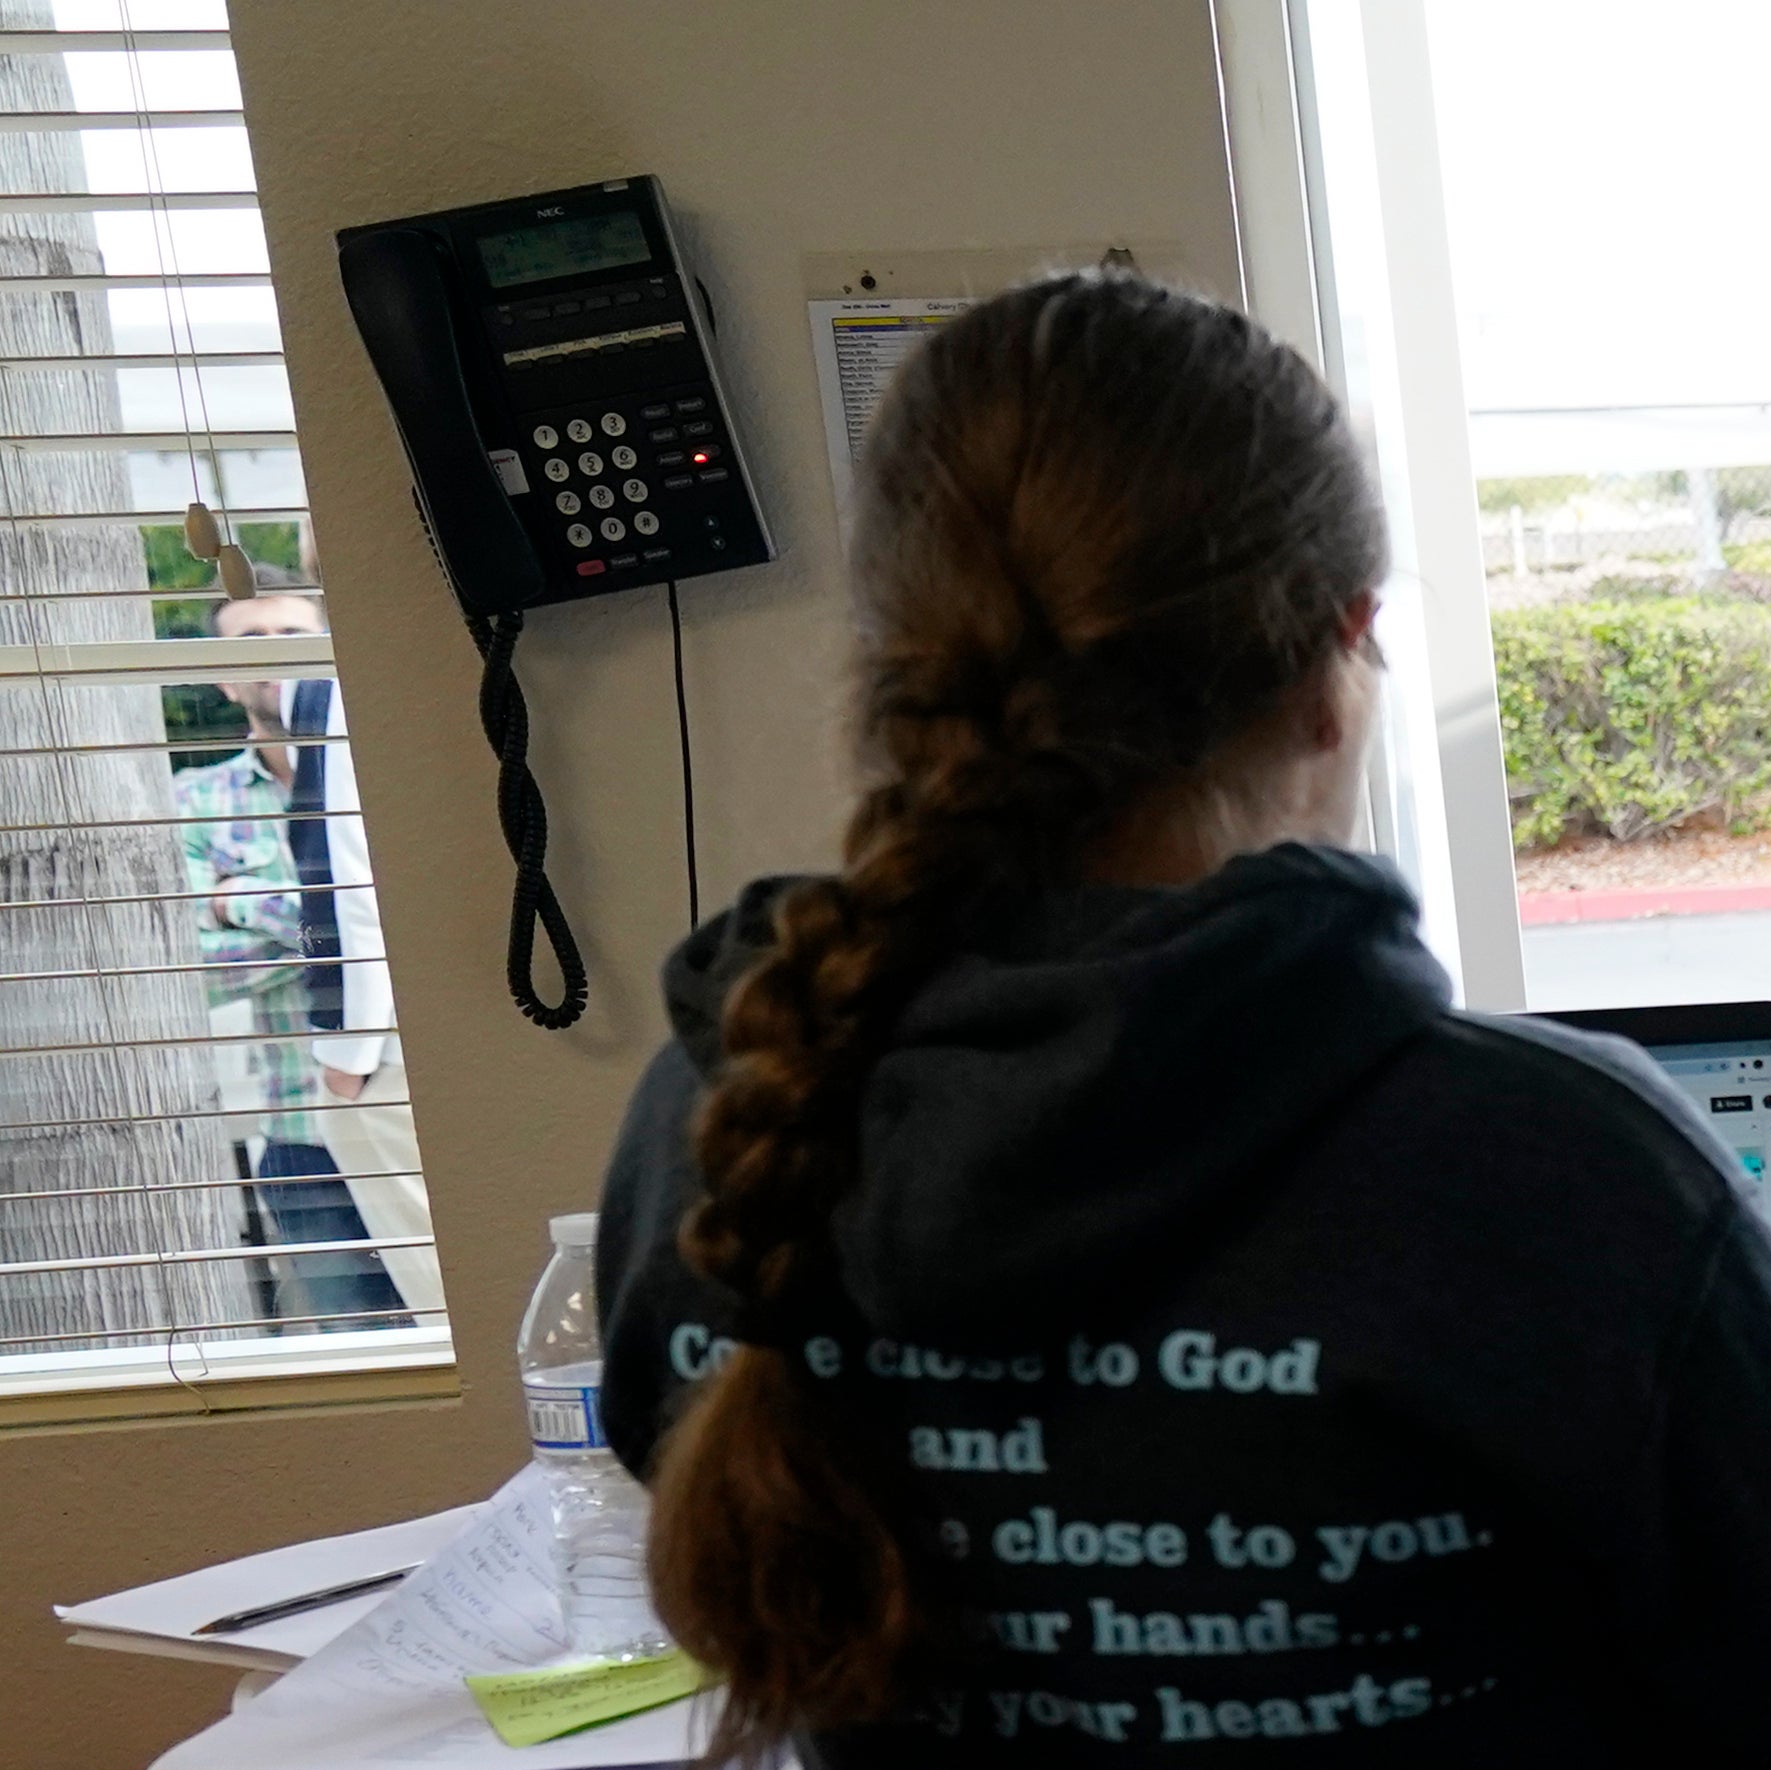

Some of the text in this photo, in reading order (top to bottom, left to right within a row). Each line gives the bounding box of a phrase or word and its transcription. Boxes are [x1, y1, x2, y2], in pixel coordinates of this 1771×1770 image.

[536, 206, 566, 220] NEC
[668, 1321, 845, 1381] Coe
[1066, 1332, 1140, 1389] to
[1157, 1327, 1324, 1396] God
[907, 1416, 1049, 1474] and
[991, 1505, 1188, 1569] close
[1205, 1511, 1297, 1570] to
[1314, 1508, 1495, 1585] you.
